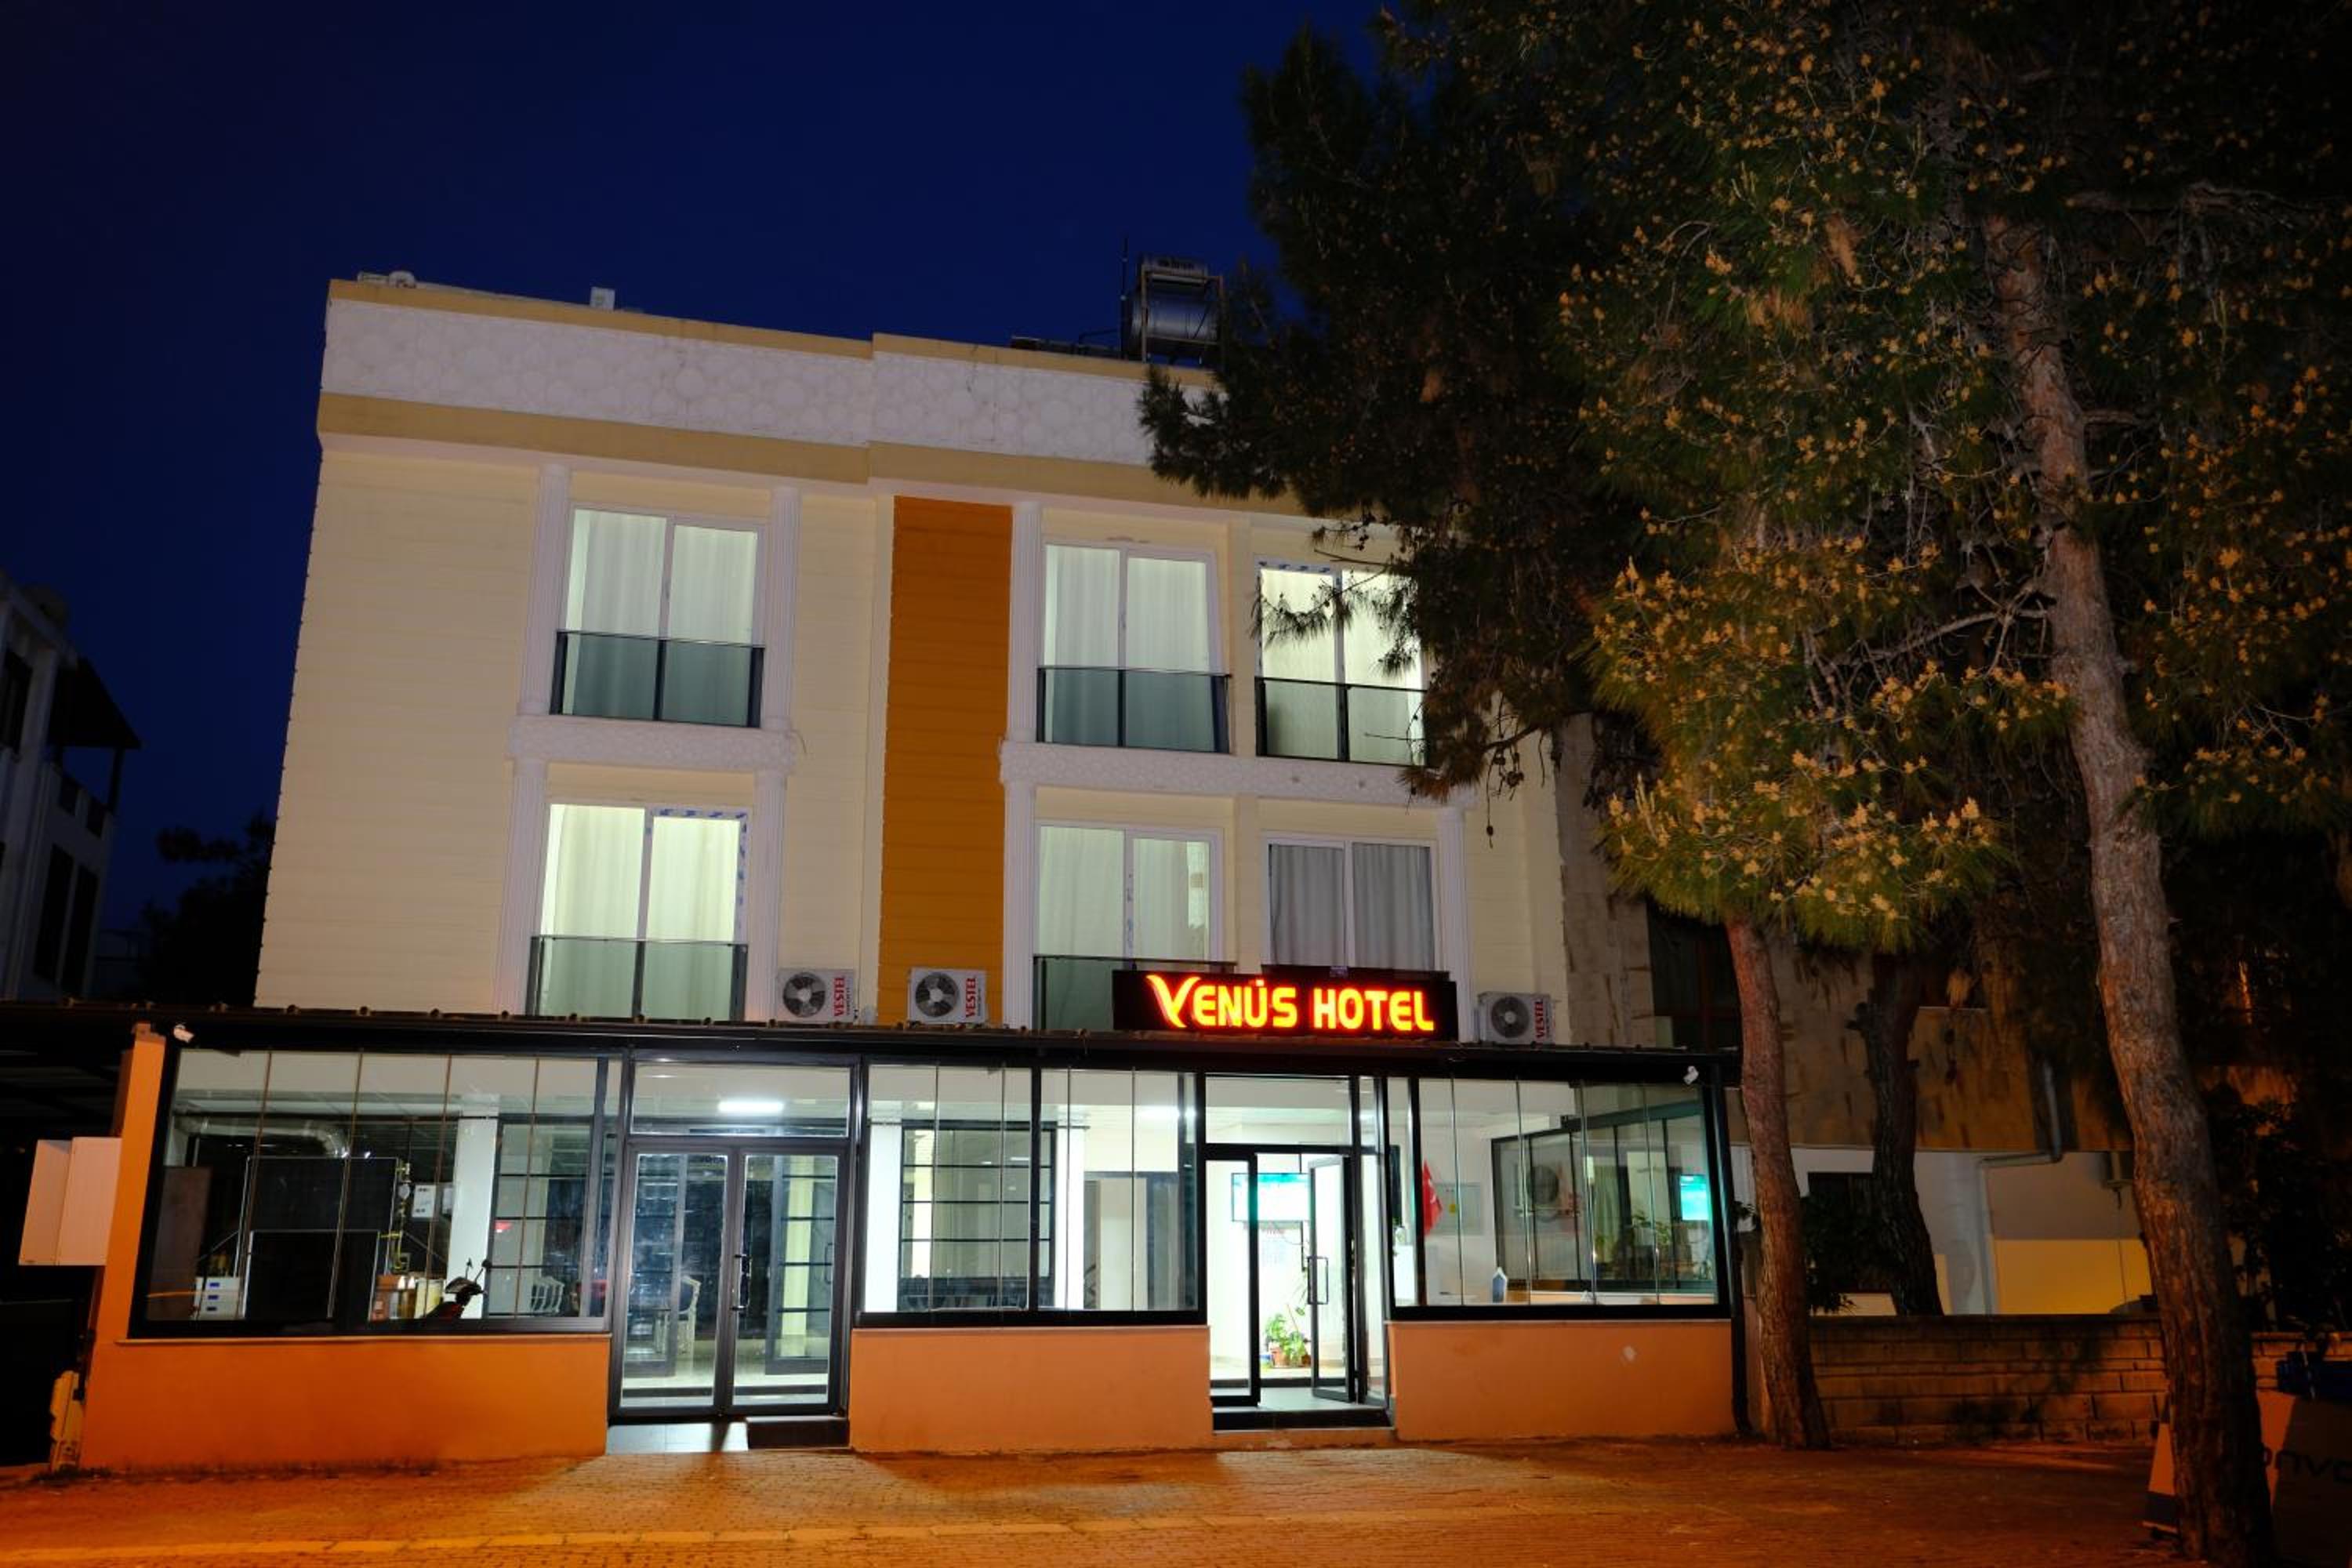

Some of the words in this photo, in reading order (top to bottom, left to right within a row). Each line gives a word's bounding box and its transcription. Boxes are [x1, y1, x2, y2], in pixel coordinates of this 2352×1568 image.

[833, 976, 845, 1017] VESTEL
[965, 976, 977, 1018] VESTEL
[1312, 987, 1436, 1031] HOTEL
